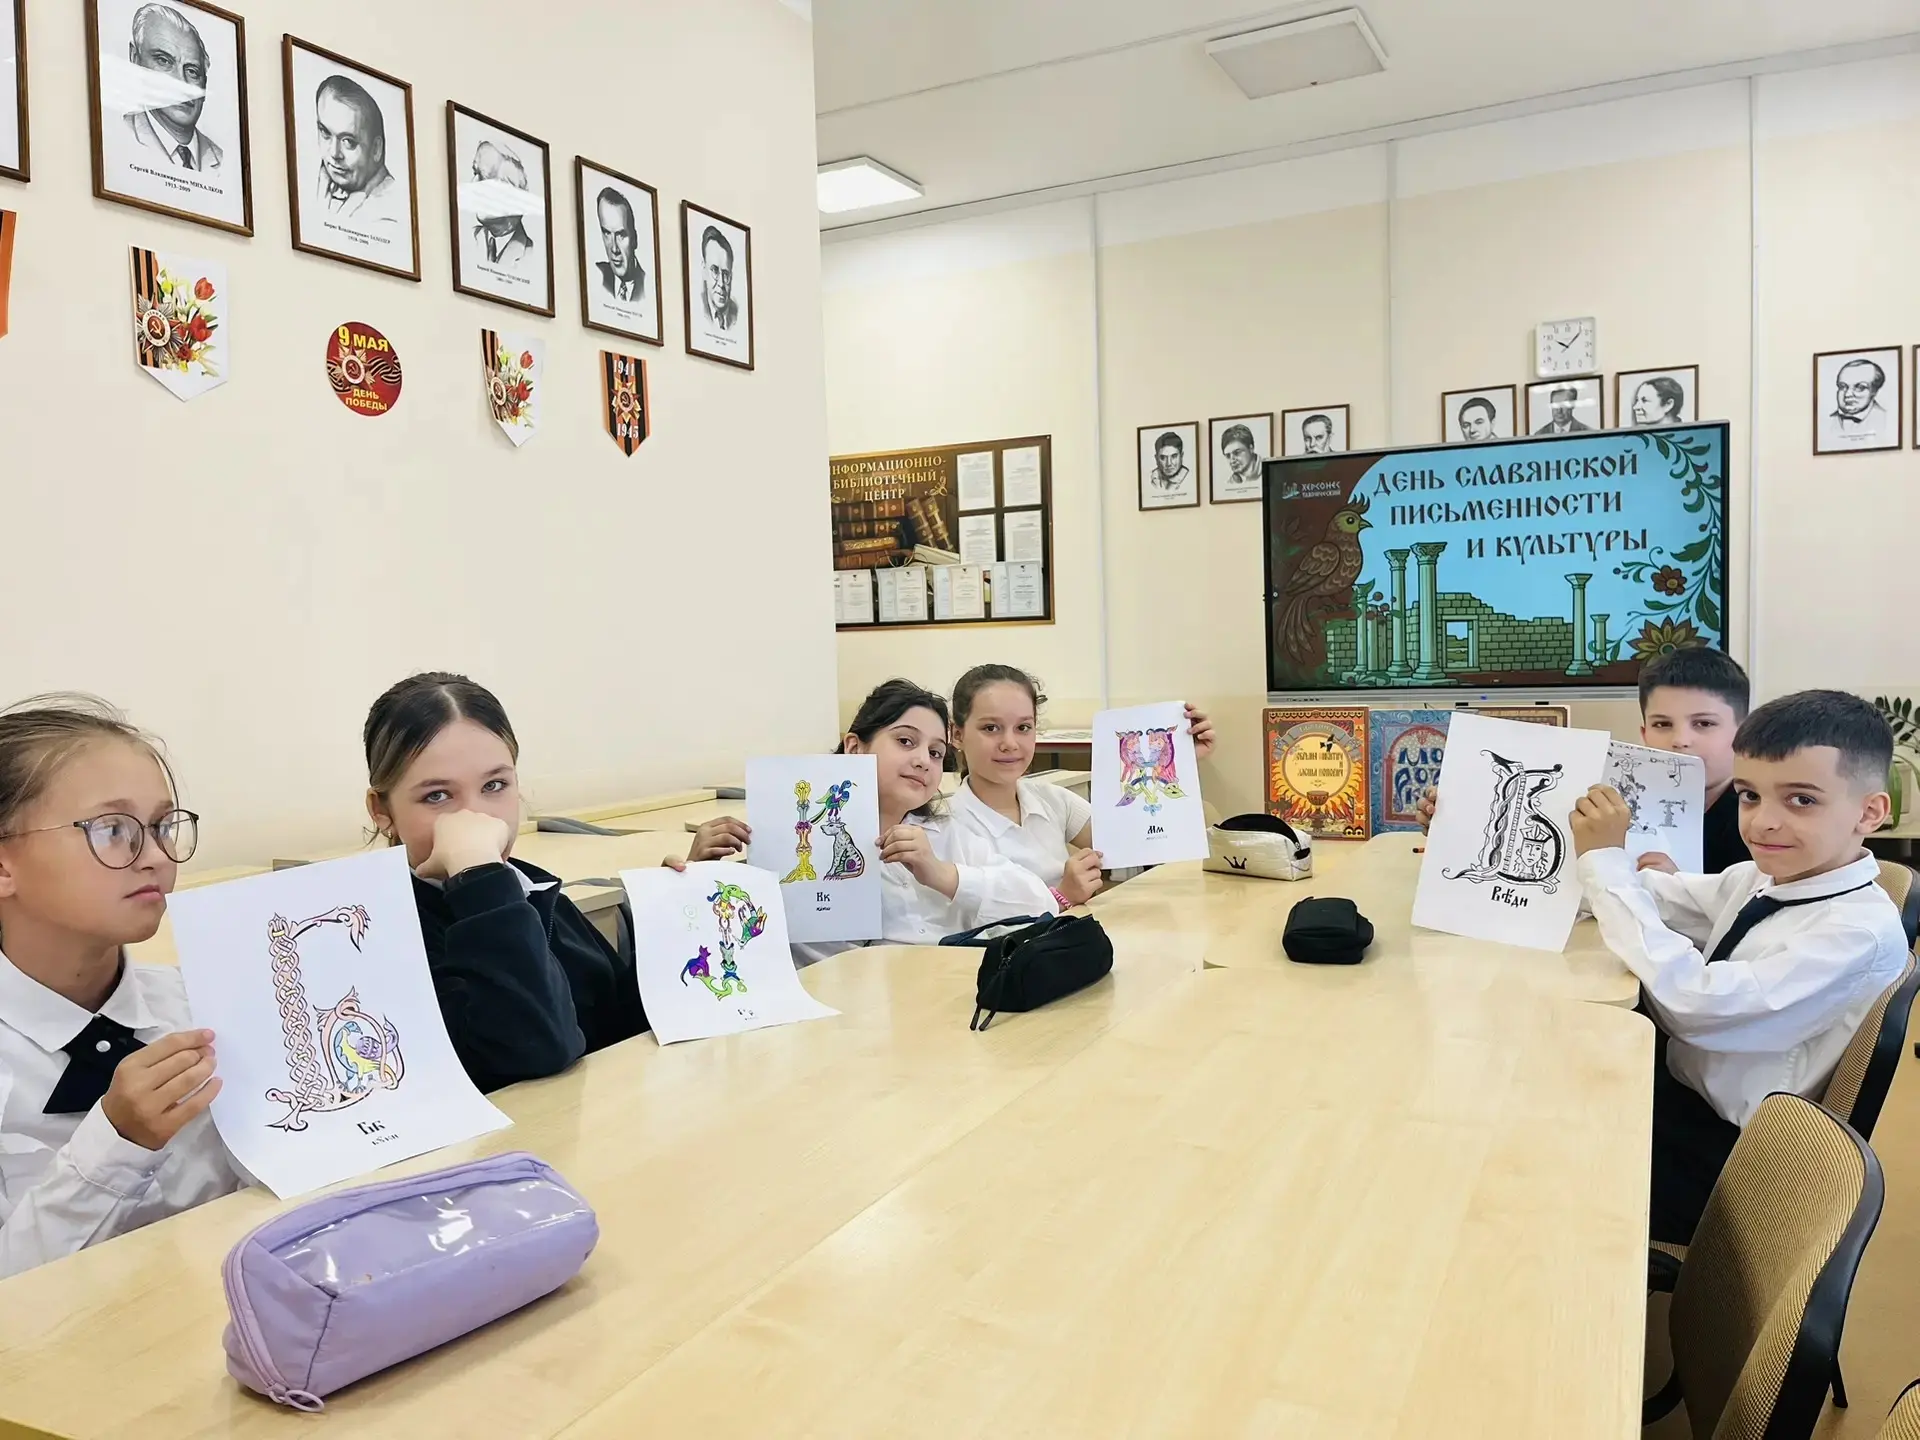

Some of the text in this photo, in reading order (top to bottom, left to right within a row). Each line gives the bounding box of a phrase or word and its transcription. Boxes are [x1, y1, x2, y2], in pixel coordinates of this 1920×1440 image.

[129, 163, 224, 195] Сергей Владимирович МИХАЛКОВ
[338, 325, 389, 352] 9 МАЯ
[613, 359, 635, 376] 1941
[345, 397, 388, 411] ПОБЕДЫ
[353, 388, 380, 400] ДЕНЬ
[616, 422, 639, 439] 1945
[829, 455, 947, 475] НФОРМАЦИОННО-
[1373, 448, 1638, 497] ДЕНЬ СЛАВЯНСКОЙ
[833, 469, 937, 489] БИБЛИОТЕЧНЫЙ
[1301, 481, 1340, 491] ХЕРСОНЕС
[864, 488, 905, 502] ЦЕНТР
[1390, 491, 1622, 526] ПИСЬМЕННОСТИ
[1466, 528, 1648, 565] И КУЛЬТУРЫ
